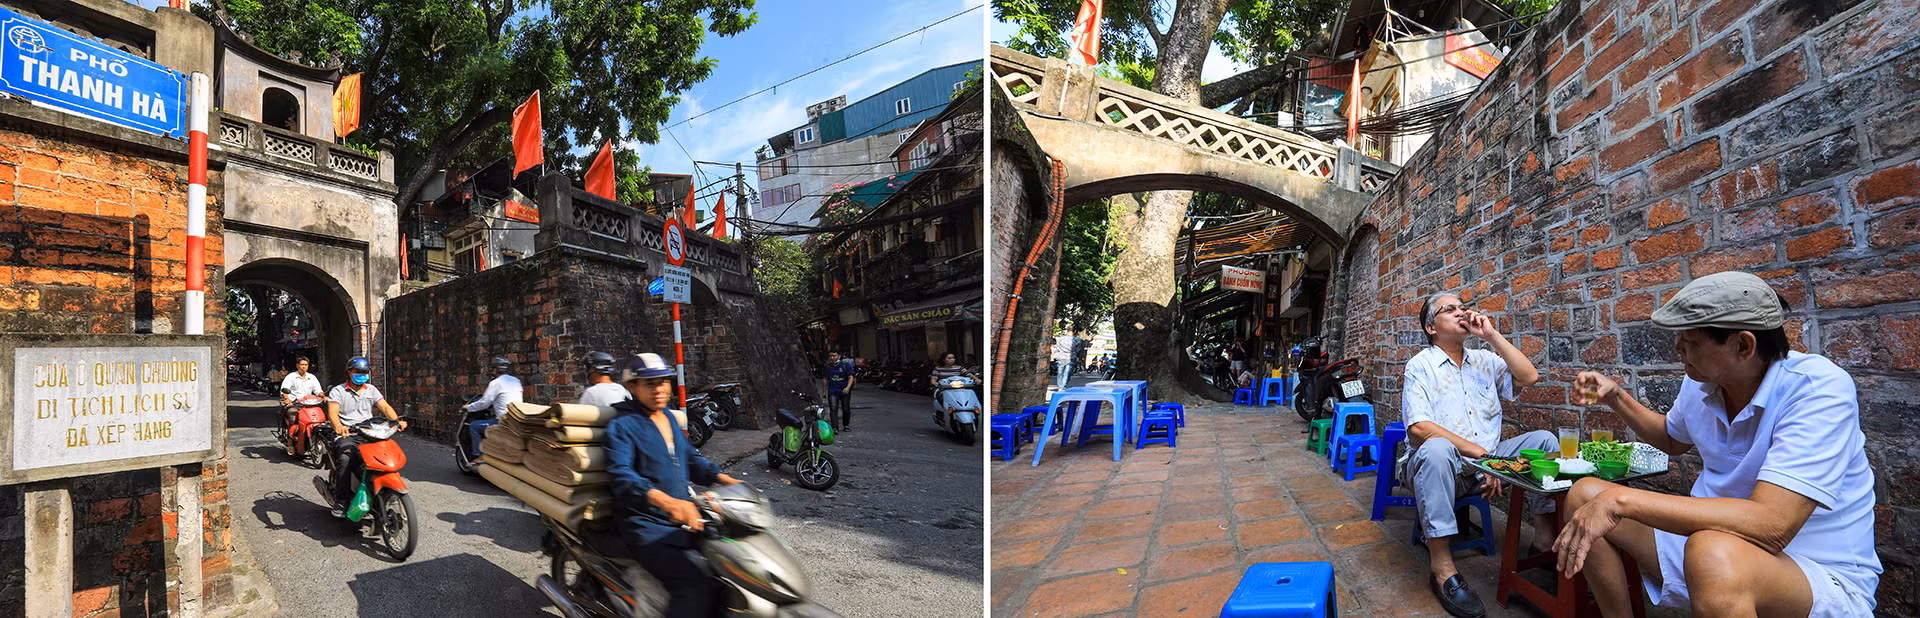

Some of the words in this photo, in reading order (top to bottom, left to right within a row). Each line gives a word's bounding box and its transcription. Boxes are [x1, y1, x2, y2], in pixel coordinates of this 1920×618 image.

[70, 48, 128, 77] PHỐ
[19, 55, 123, 109] THANH
[132, 92, 167, 122] HÀ
[921, 307, 951, 318] CHÁO
[93, 361, 136, 387] QUAN
[119, 393, 166, 417] LỊCH
